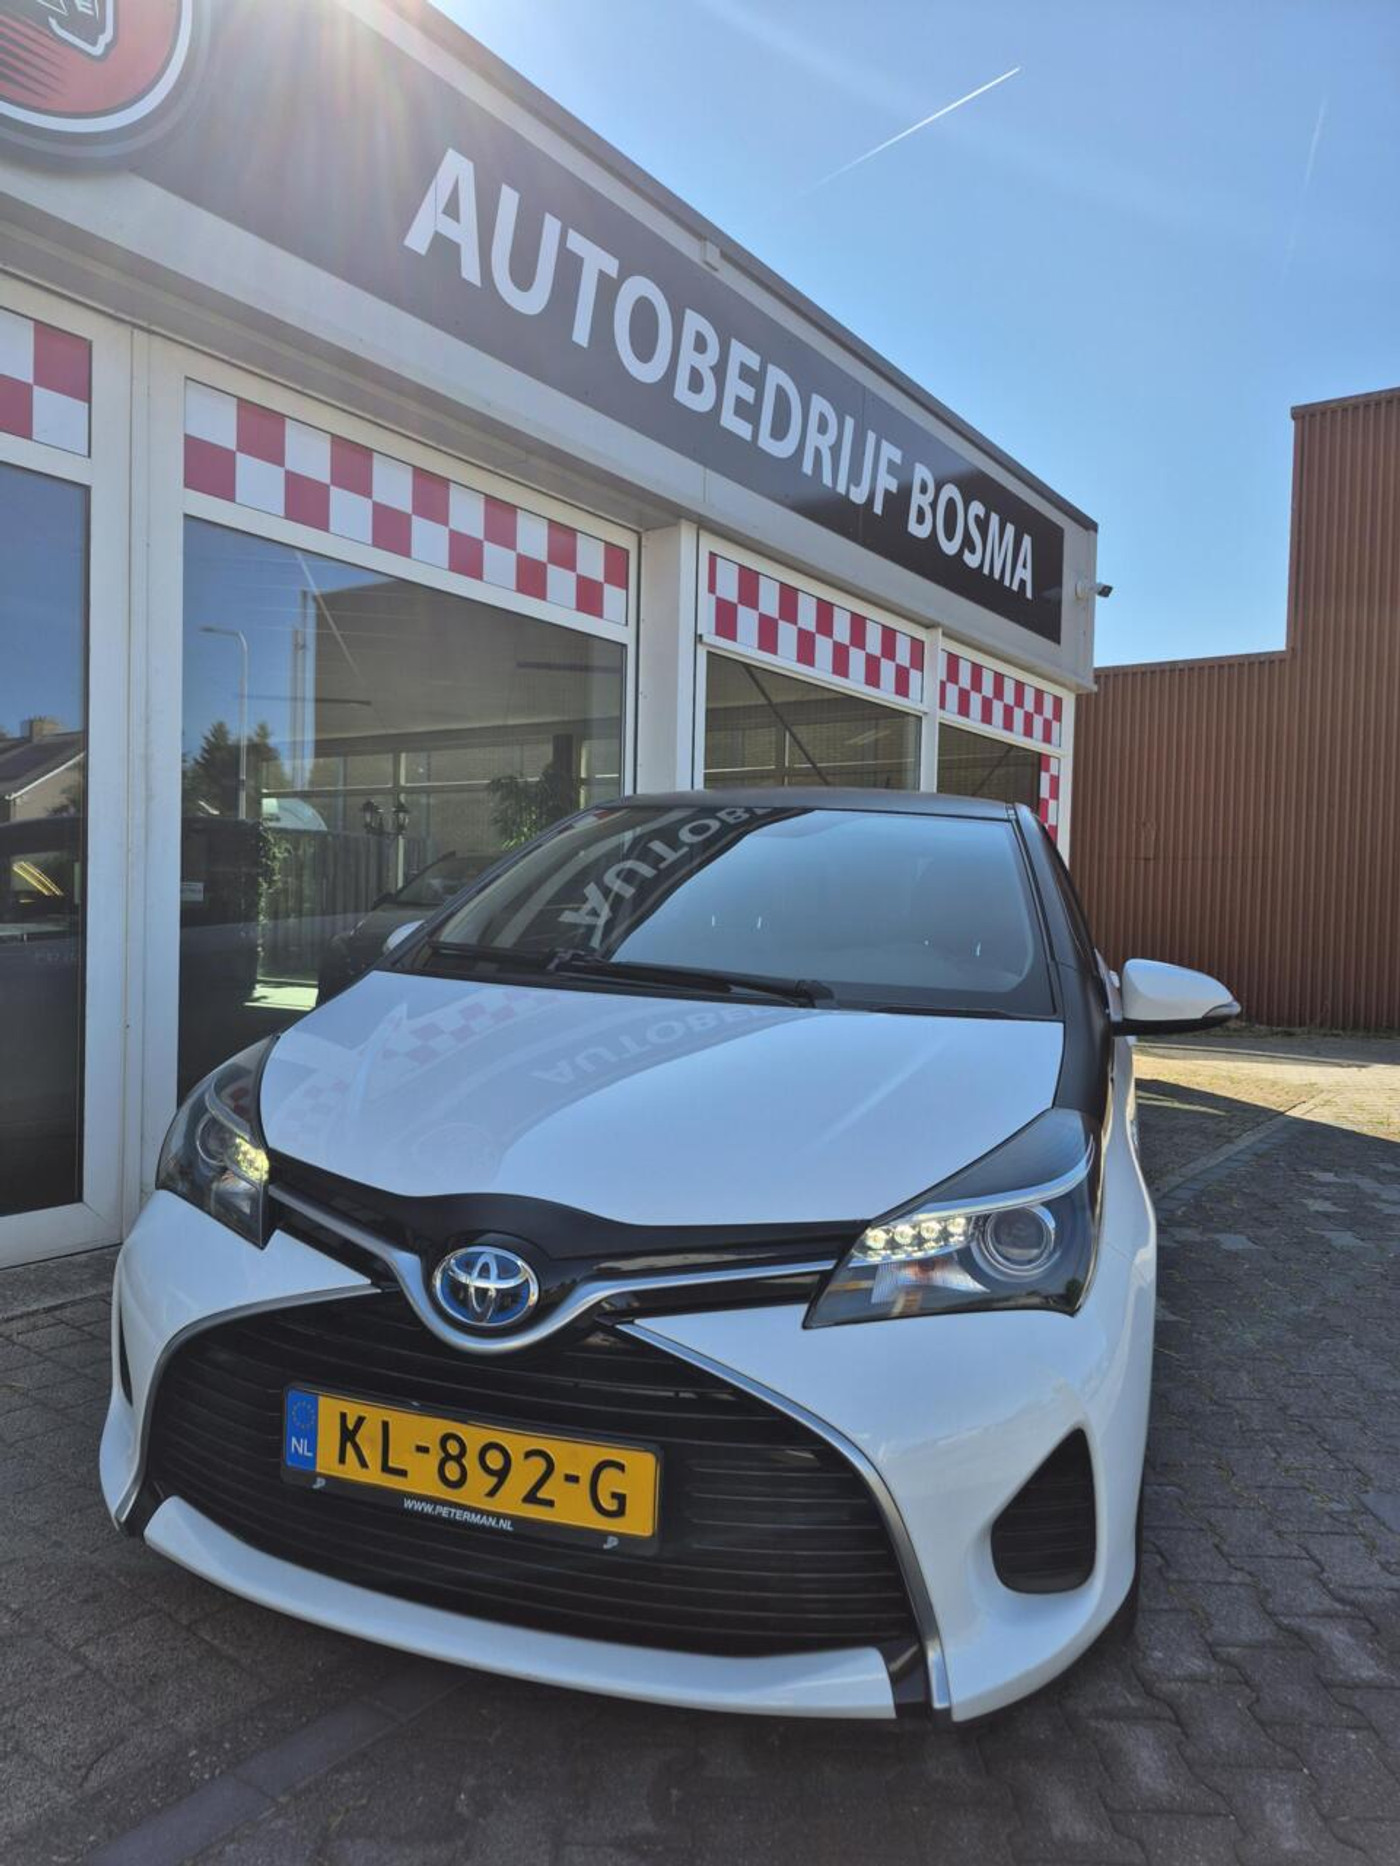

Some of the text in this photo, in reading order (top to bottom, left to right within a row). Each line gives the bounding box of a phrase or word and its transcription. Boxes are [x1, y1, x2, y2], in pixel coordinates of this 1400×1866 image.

[403, 147, 1033, 600] AUTOBEDRIJF BOSMA
[291, 1438, 313, 1457] NL
[338, 1411, 627, 1519] KL-892-G
[403, 1498, 515, 1531] WWW.PETERMAN.NL
